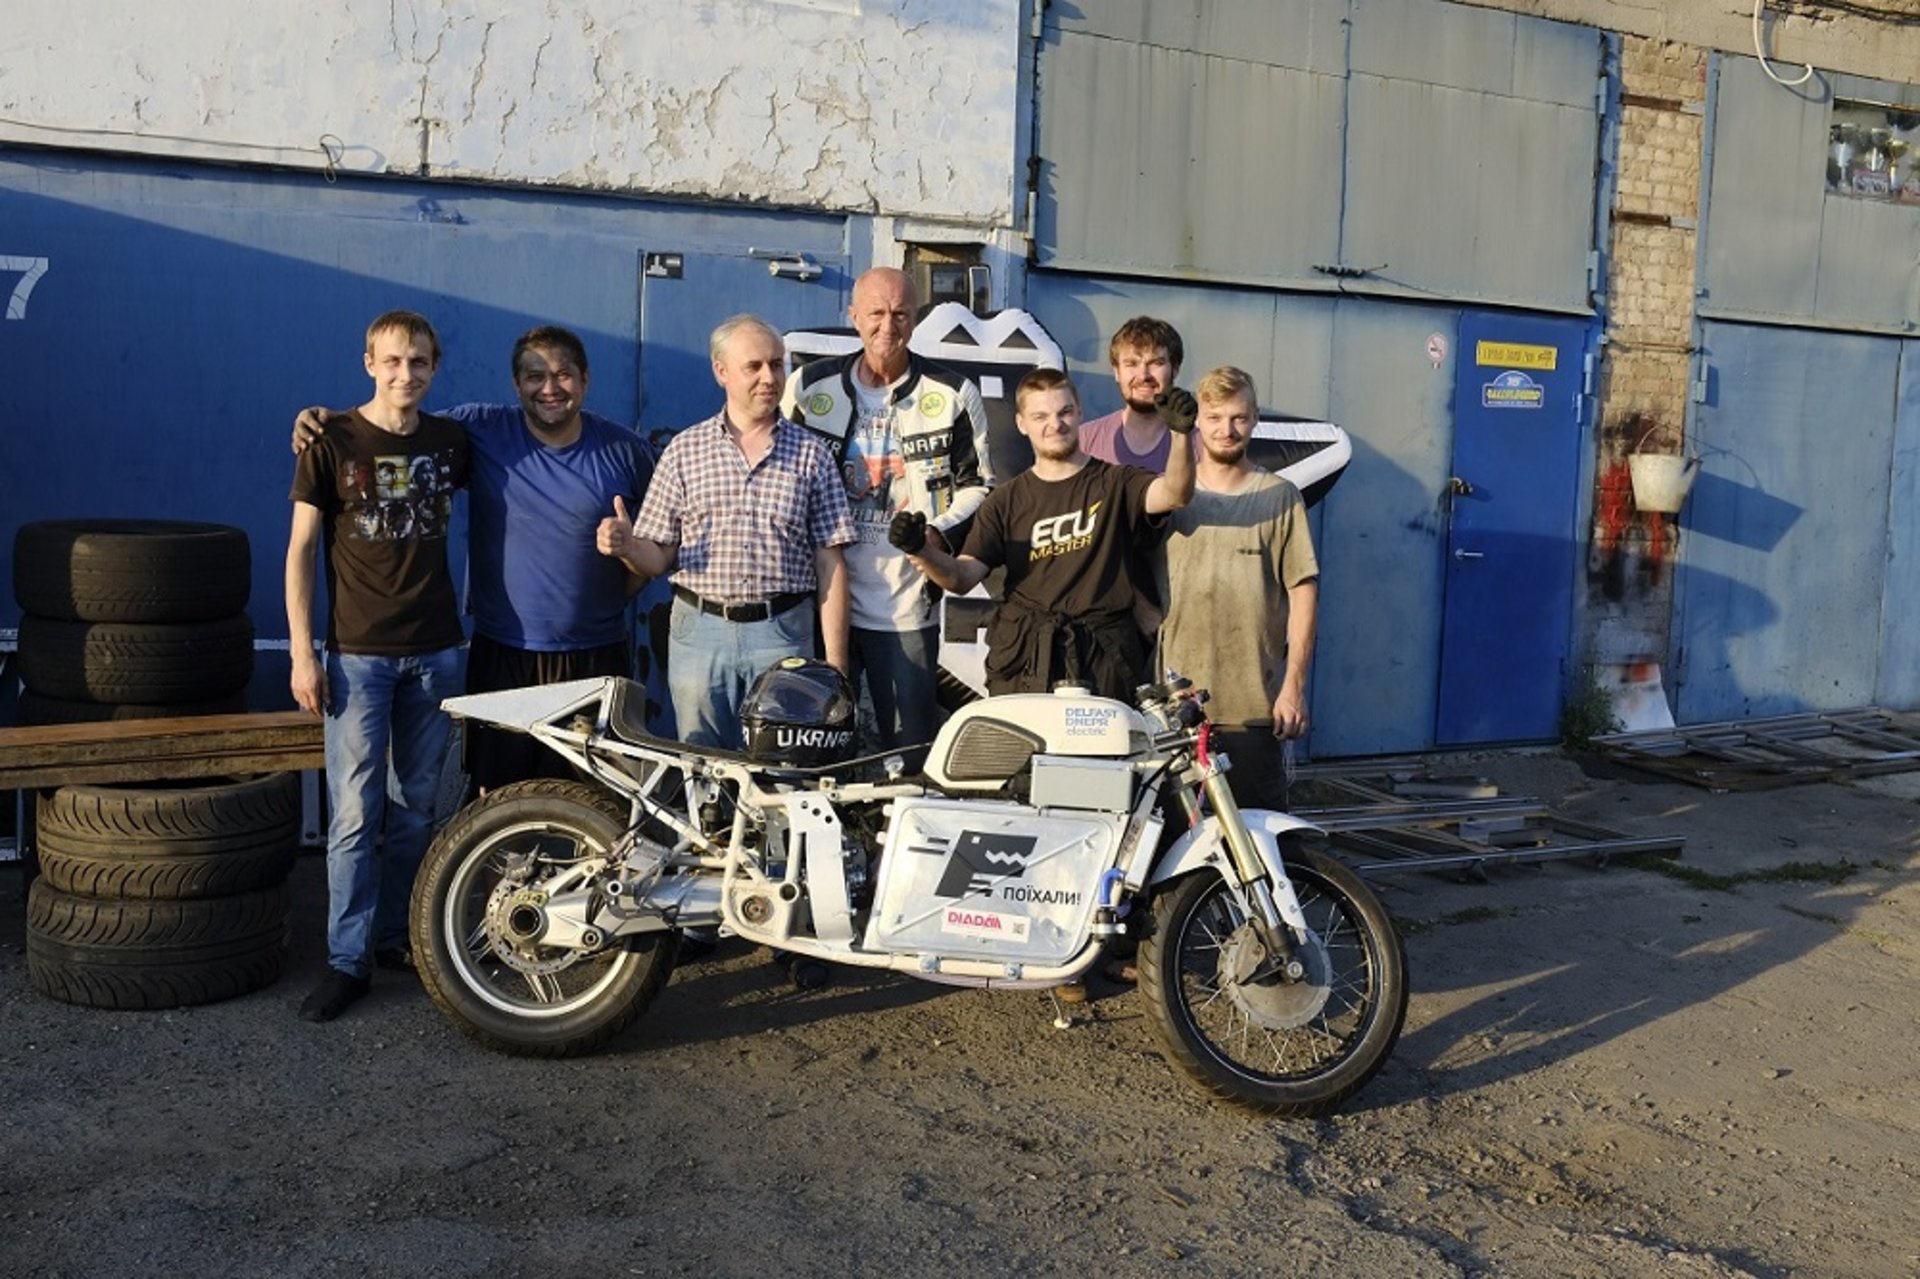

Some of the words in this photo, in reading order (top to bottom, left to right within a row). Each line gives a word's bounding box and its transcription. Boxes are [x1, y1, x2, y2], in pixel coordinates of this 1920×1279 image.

[0, 254, 49, 319] 7
[1031, 508, 1097, 548] ECU
[1029, 534, 1093, 562] MASTER
[1065, 707, 1118, 718] DELFAST
[1065, 717, 1110, 726] DNEPR
[1003, 884, 1081, 906] ПОЇХАЛИ!
